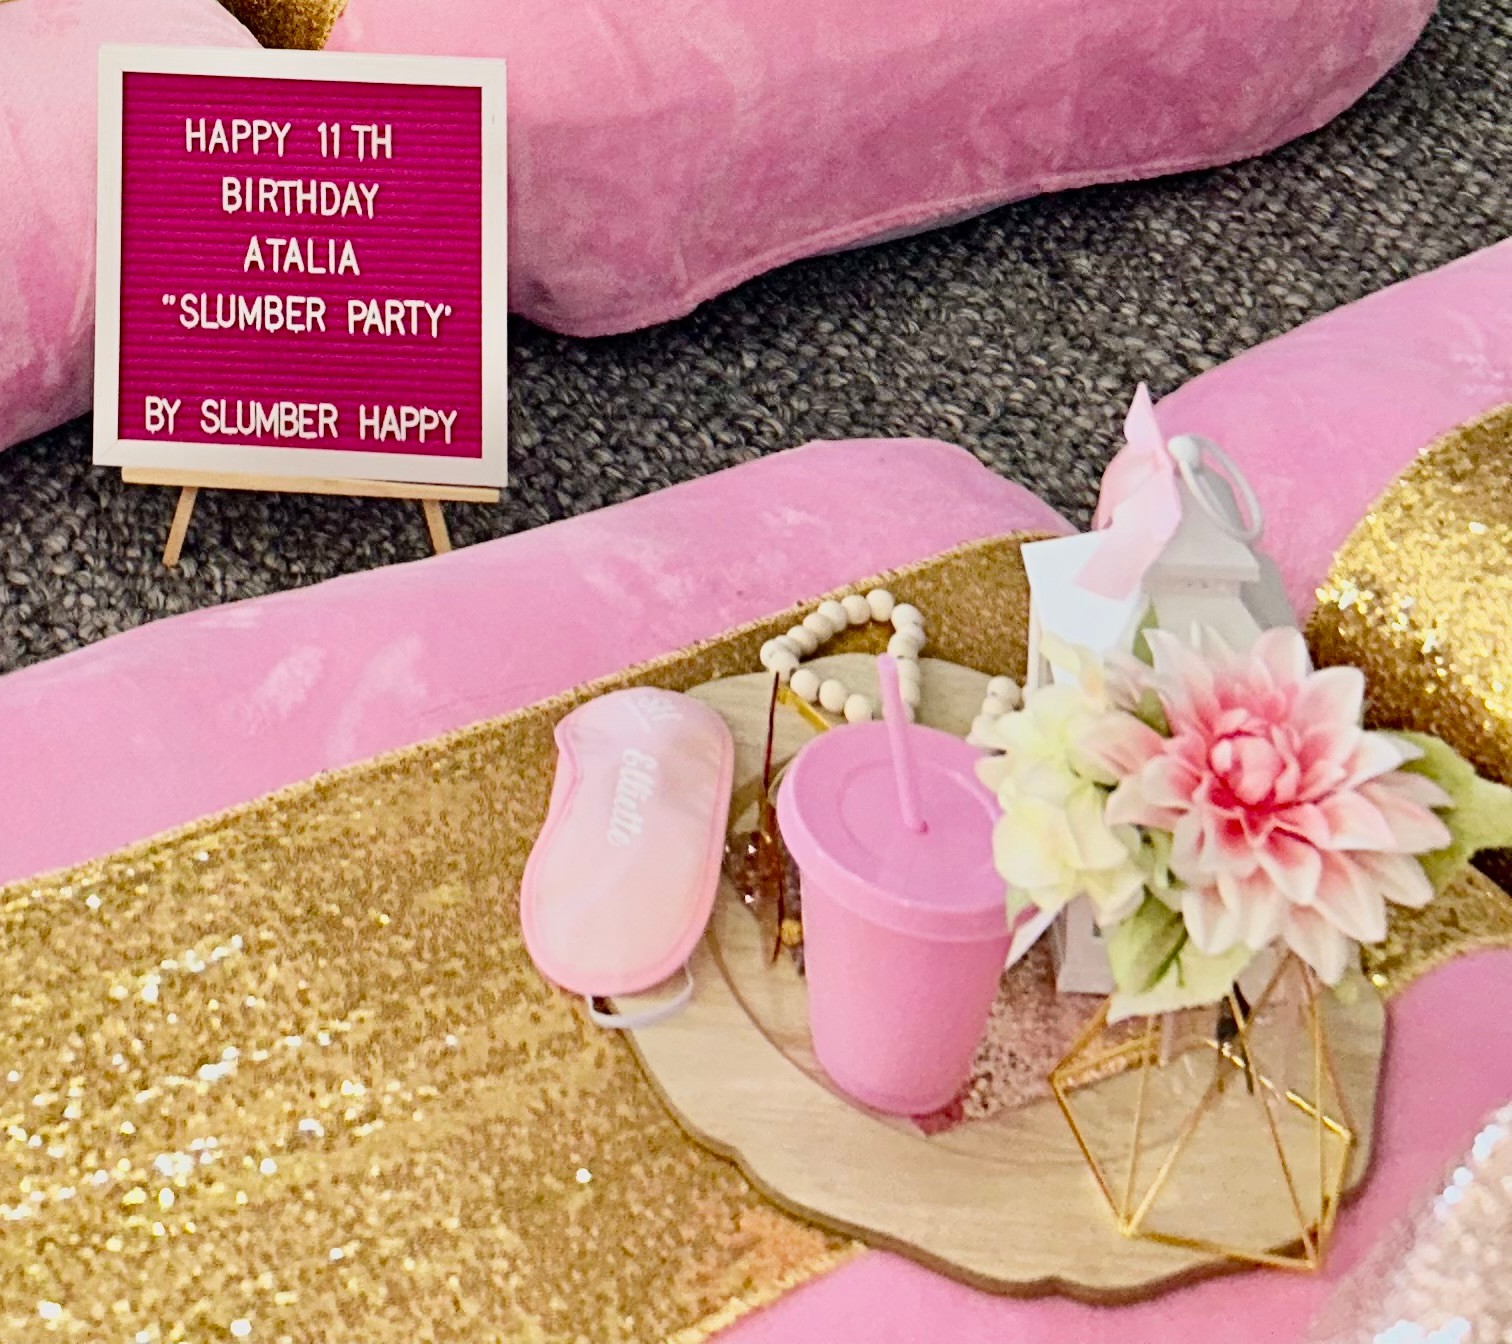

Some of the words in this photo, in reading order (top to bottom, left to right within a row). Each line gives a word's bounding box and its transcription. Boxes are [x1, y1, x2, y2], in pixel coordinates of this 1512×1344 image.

[185, 118, 292, 157] HAPPY
[221, 176, 380, 219] BIRTHDAY
[243, 235, 361, 276] ATALIA
[162, 292, 327, 333] "SLUMBER
[144, 395, 182, 435] BY
[199, 398, 339, 440] SLUMBER
[359, 403, 458, 445] HAPPY
